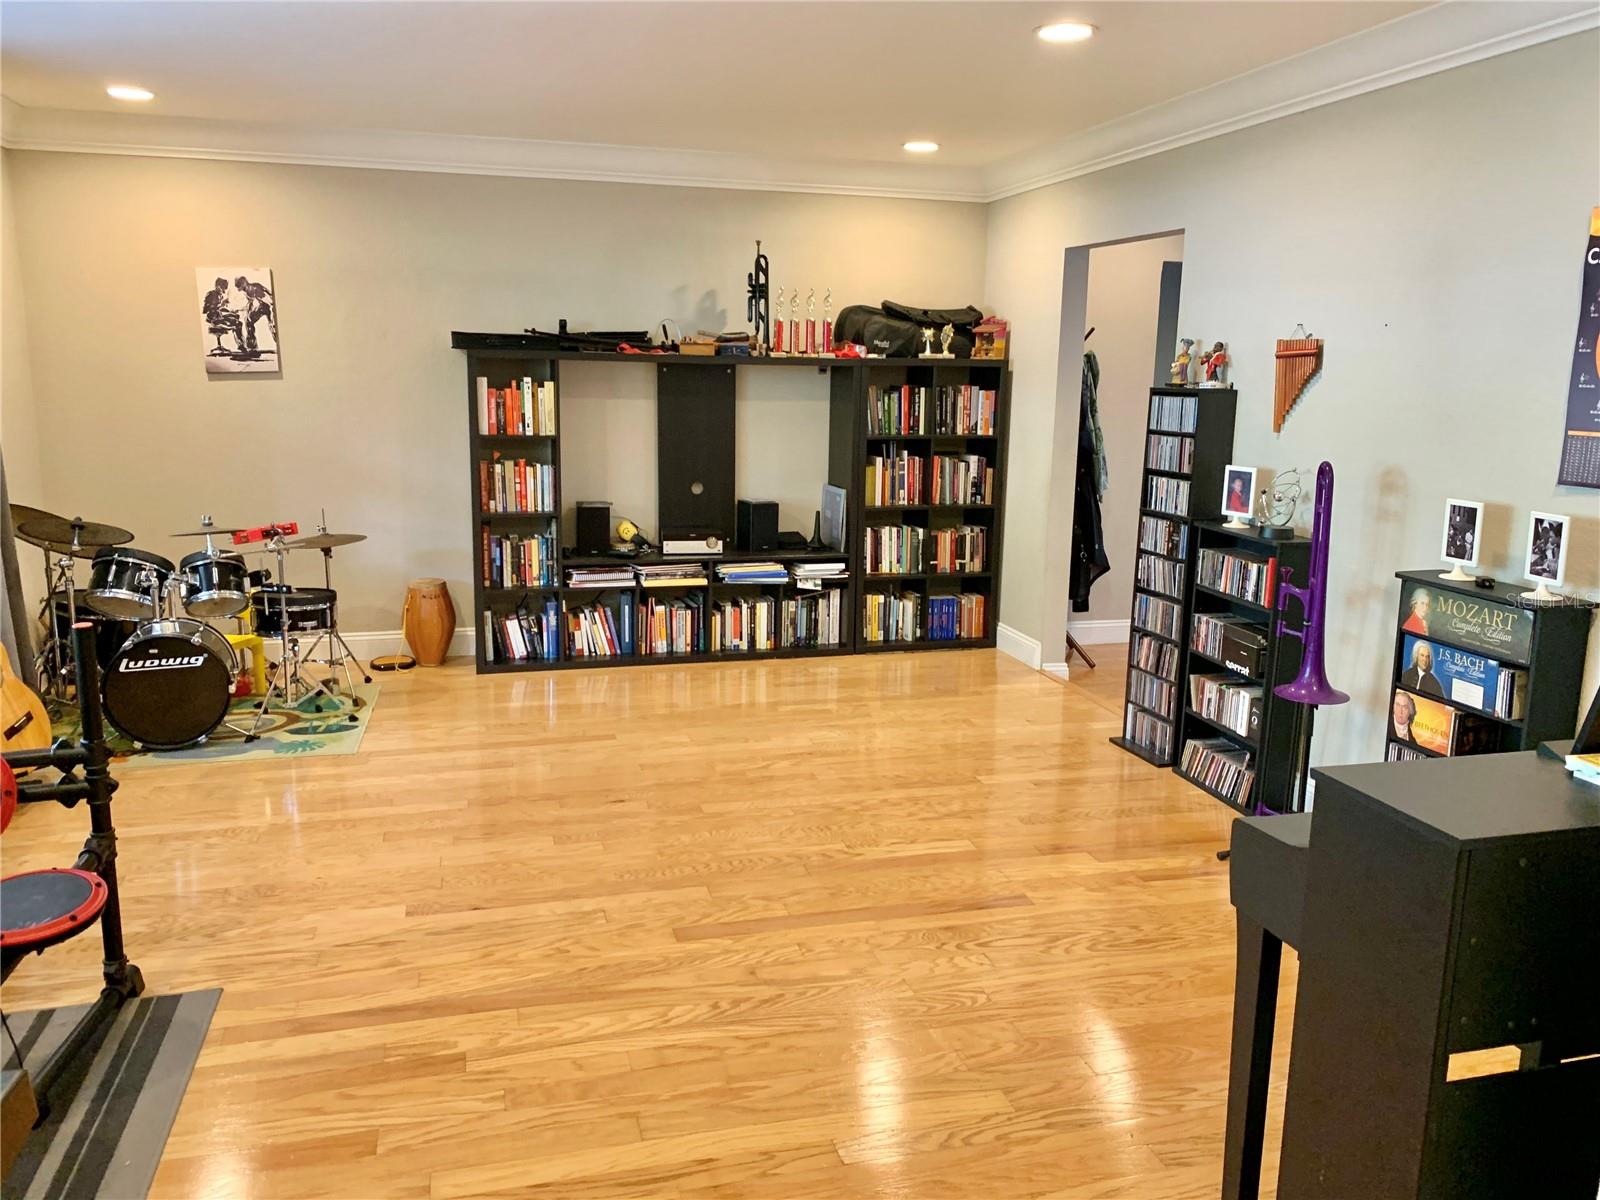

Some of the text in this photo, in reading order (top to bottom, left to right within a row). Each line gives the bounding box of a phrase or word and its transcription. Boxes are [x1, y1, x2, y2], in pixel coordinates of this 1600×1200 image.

[1436, 596, 1518, 631] MOZART
[1448, 617, 1512, 643] Complete Edition
[1438, 648, 1485, 672] J.S. BACH
